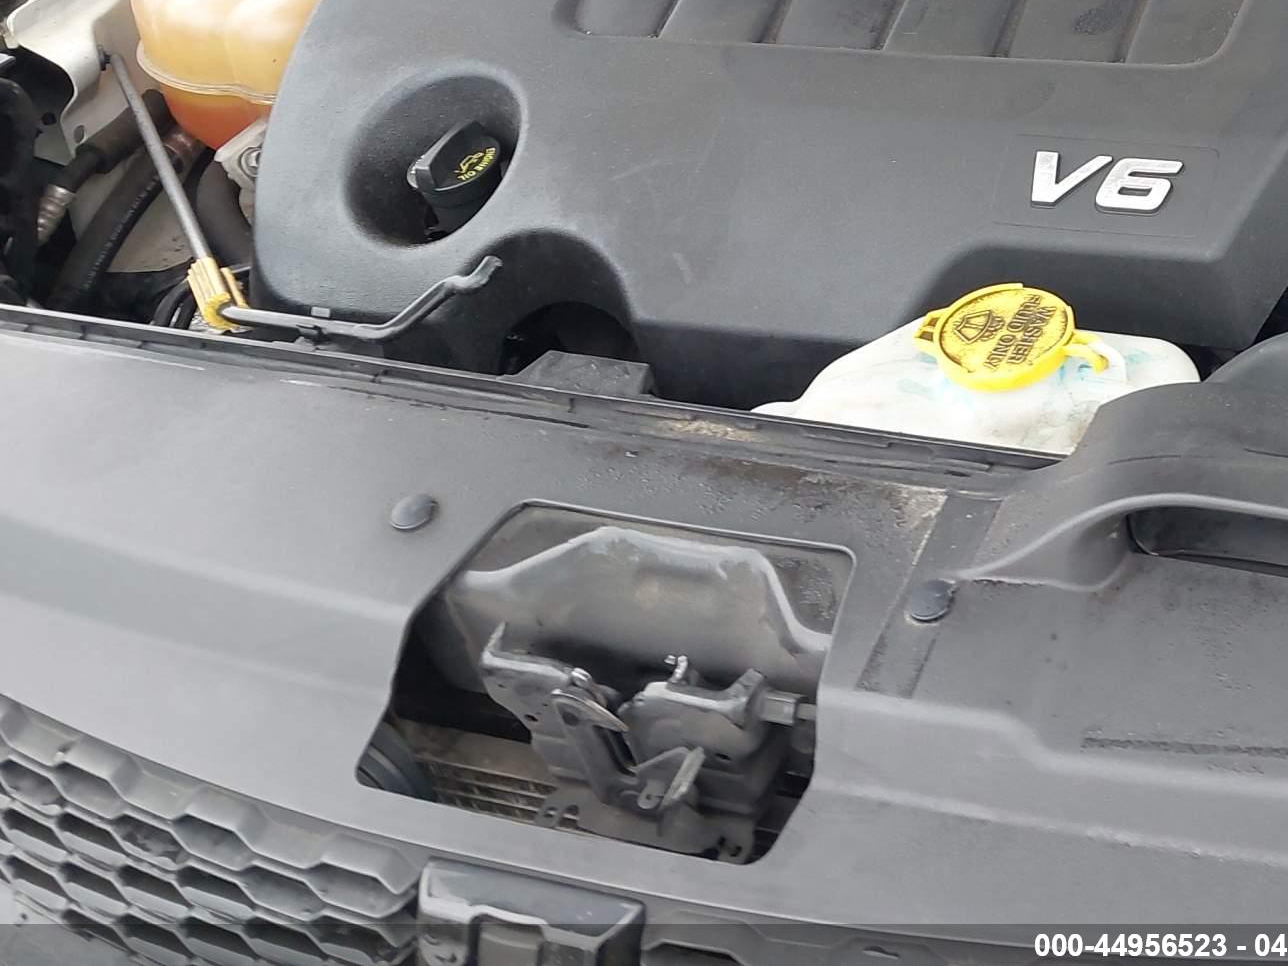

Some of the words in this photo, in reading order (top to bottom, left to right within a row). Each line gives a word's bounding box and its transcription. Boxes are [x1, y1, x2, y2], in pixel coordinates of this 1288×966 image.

[457, 170, 476, 181] OIL
[1031, 150, 1184, 212] V6
[1006, 294, 1042, 332] FLUID
[983, 334, 1017, 370] ONLY
[1006, 305, 1057, 365] WASHER
